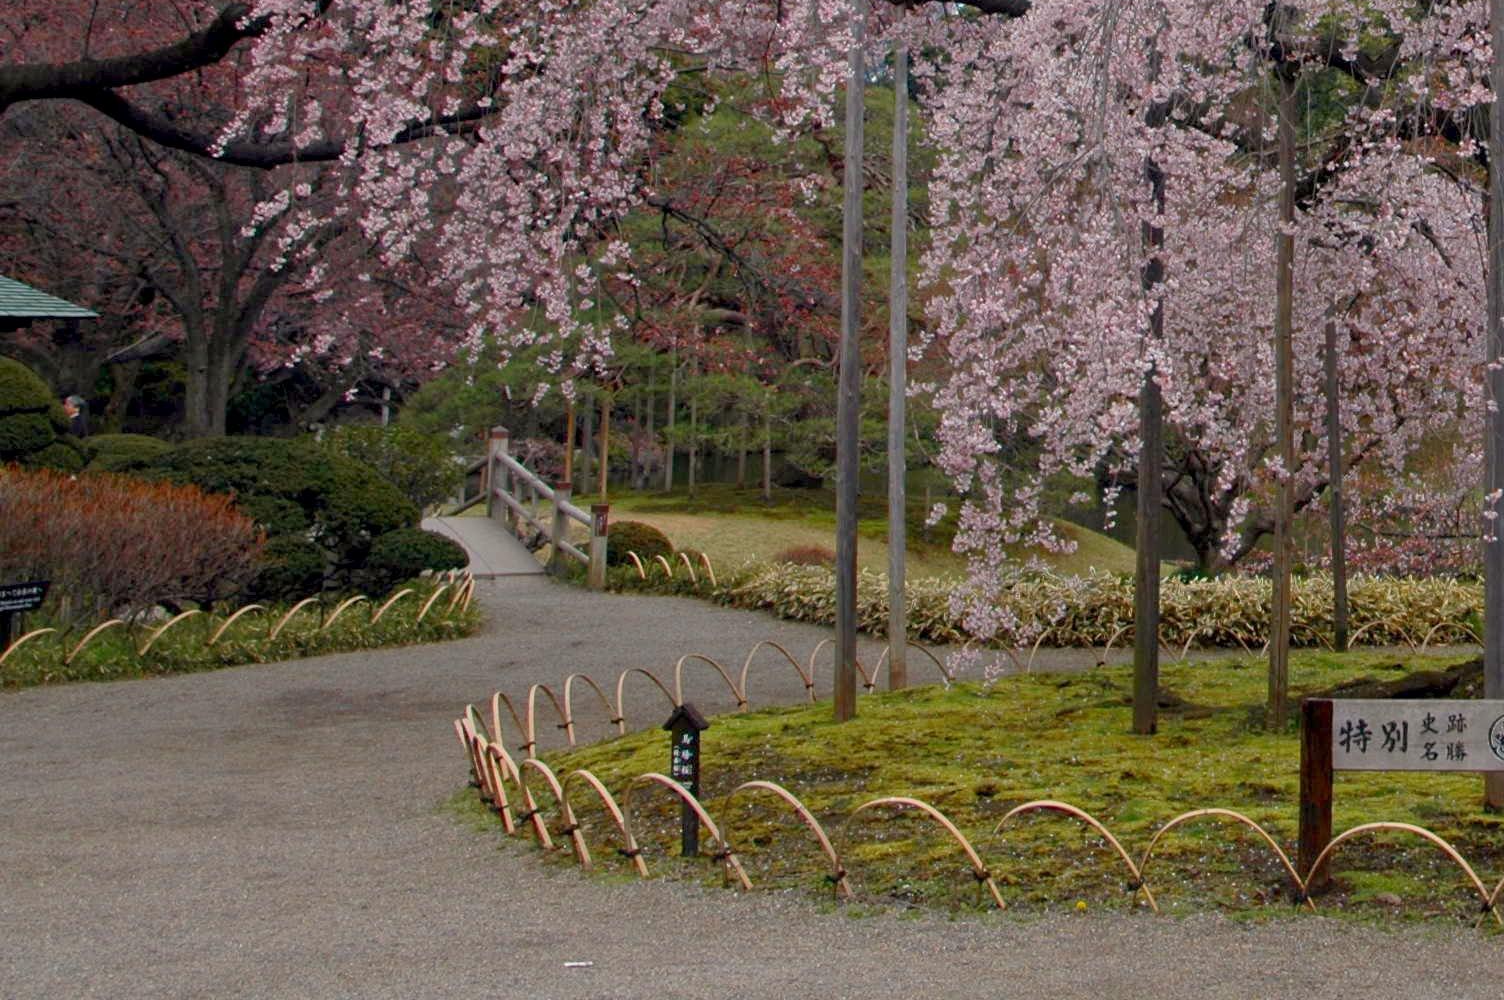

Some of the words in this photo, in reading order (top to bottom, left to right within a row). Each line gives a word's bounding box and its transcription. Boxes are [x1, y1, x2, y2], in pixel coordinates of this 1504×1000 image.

[1420, 711, 1468, 734] 史跡
[1339, 718, 1409, 754] 特別
[1420, 741, 1468, 761] 名勝
